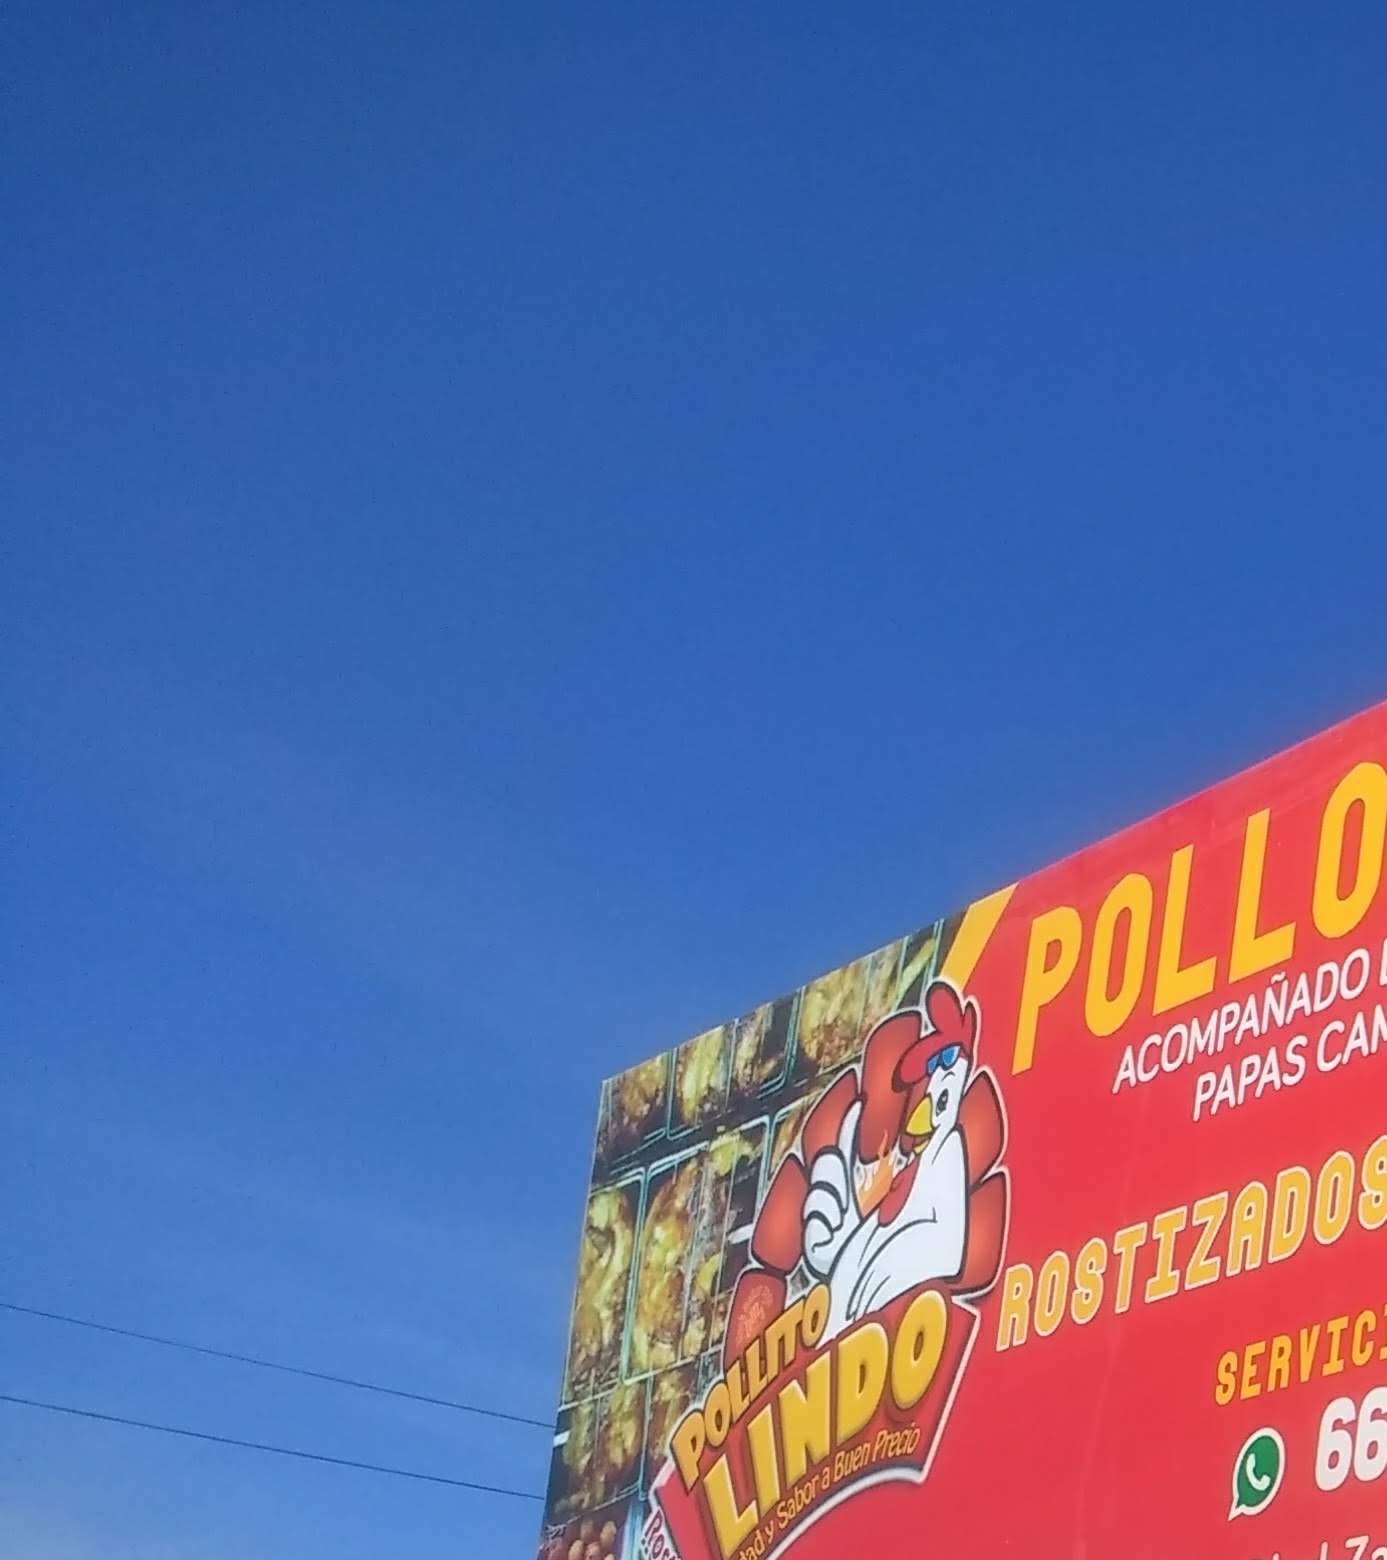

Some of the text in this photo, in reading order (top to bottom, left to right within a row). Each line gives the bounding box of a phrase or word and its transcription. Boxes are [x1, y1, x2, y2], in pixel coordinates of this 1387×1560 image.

[1112, 948, 1371, 1094] ACOMPAÑADO
[1193, 1035, 1308, 1122] PAPAS
[671, 1283, 830, 1491] POLLITO
[764, 1521, 775, 1542] y
[776, 1474, 820, 1529] Sabor
[820, 1469, 830, 1490] a
[833, 1443, 870, 1482] Buen
[874, 1421, 922, 1460] Precio
